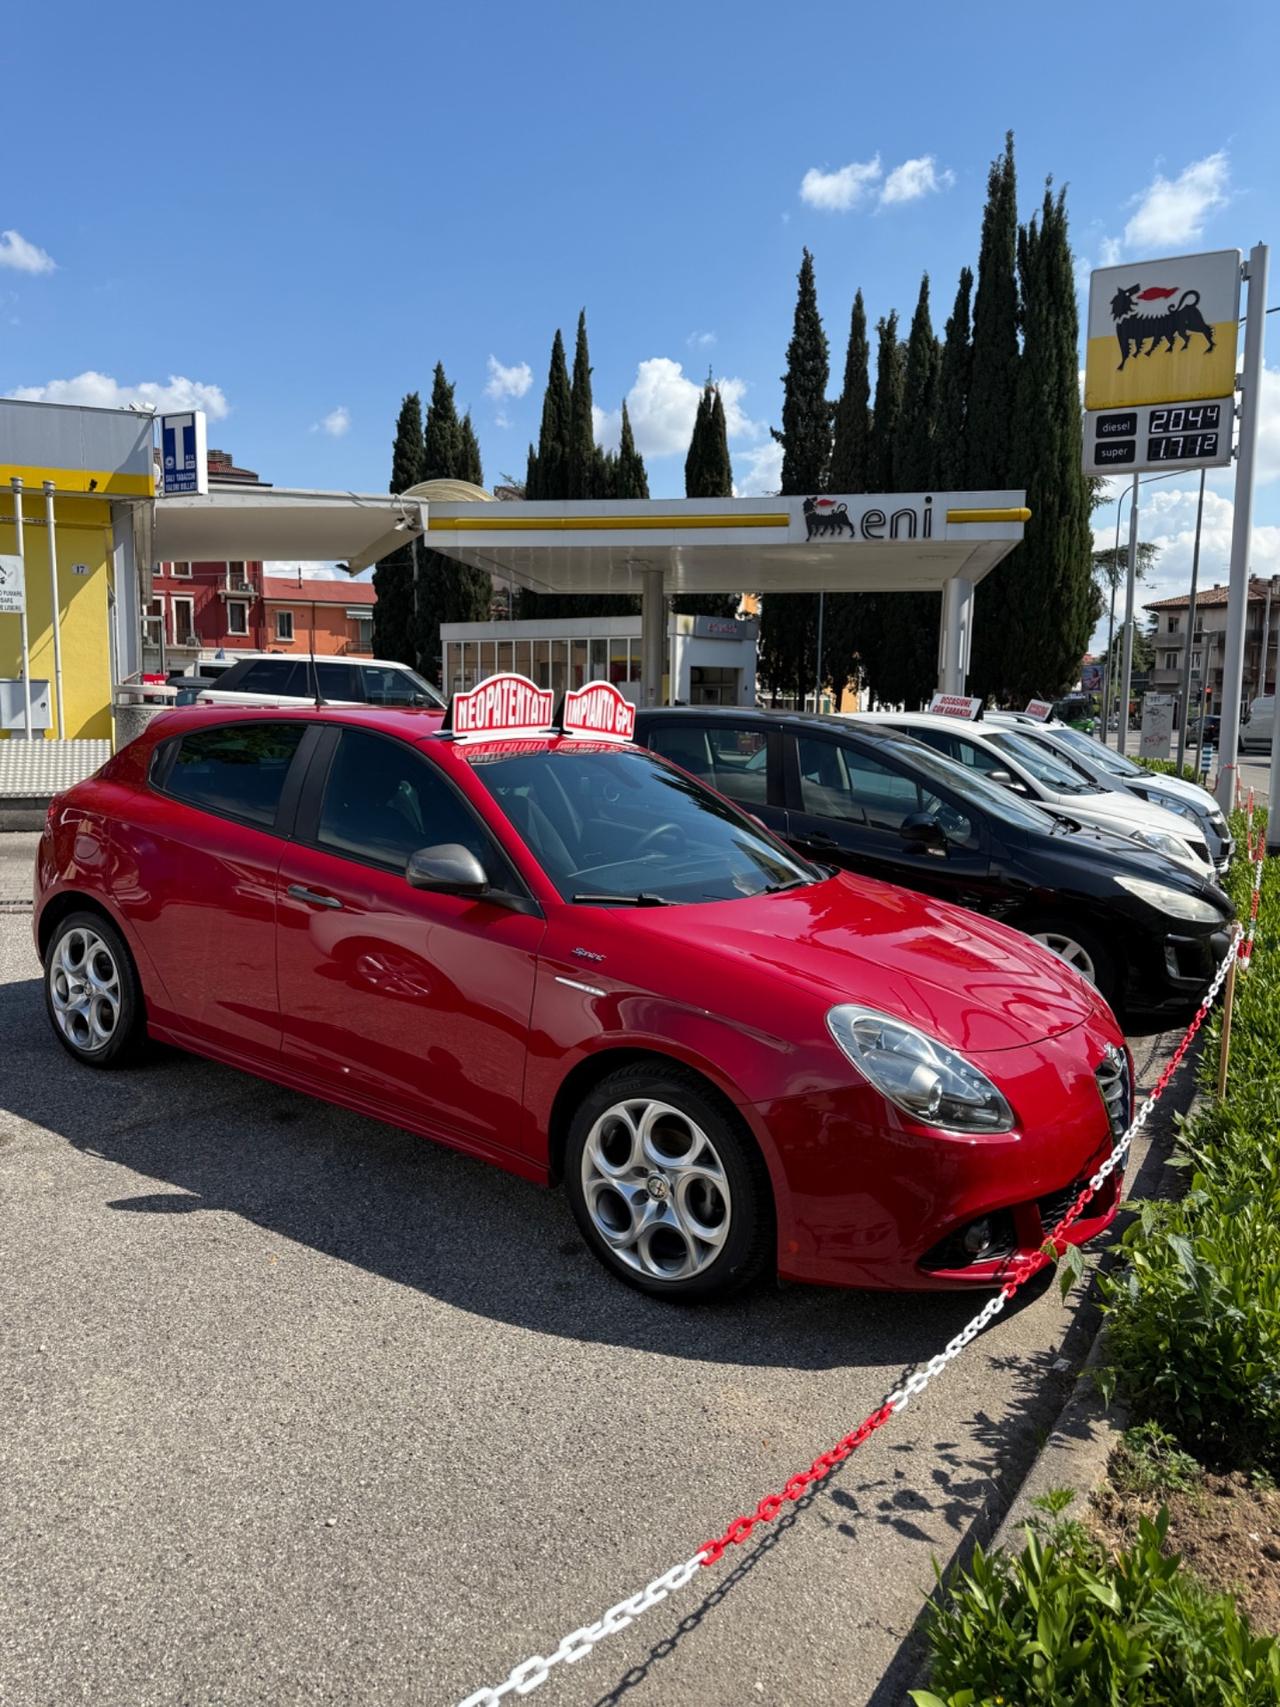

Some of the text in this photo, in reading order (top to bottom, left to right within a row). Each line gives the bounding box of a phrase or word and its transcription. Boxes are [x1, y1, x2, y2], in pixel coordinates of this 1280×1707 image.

[165, 415, 193, 470] T
[1102, 421, 1130, 433] diesel
[1101, 446, 1128, 459] super
[861, 496, 933, 539] eni
[76, 565, 85, 574] 17
[458, 679, 550, 730] NEOPATENTATI
[567, 689, 632, 734] IMPIANTO GPL
